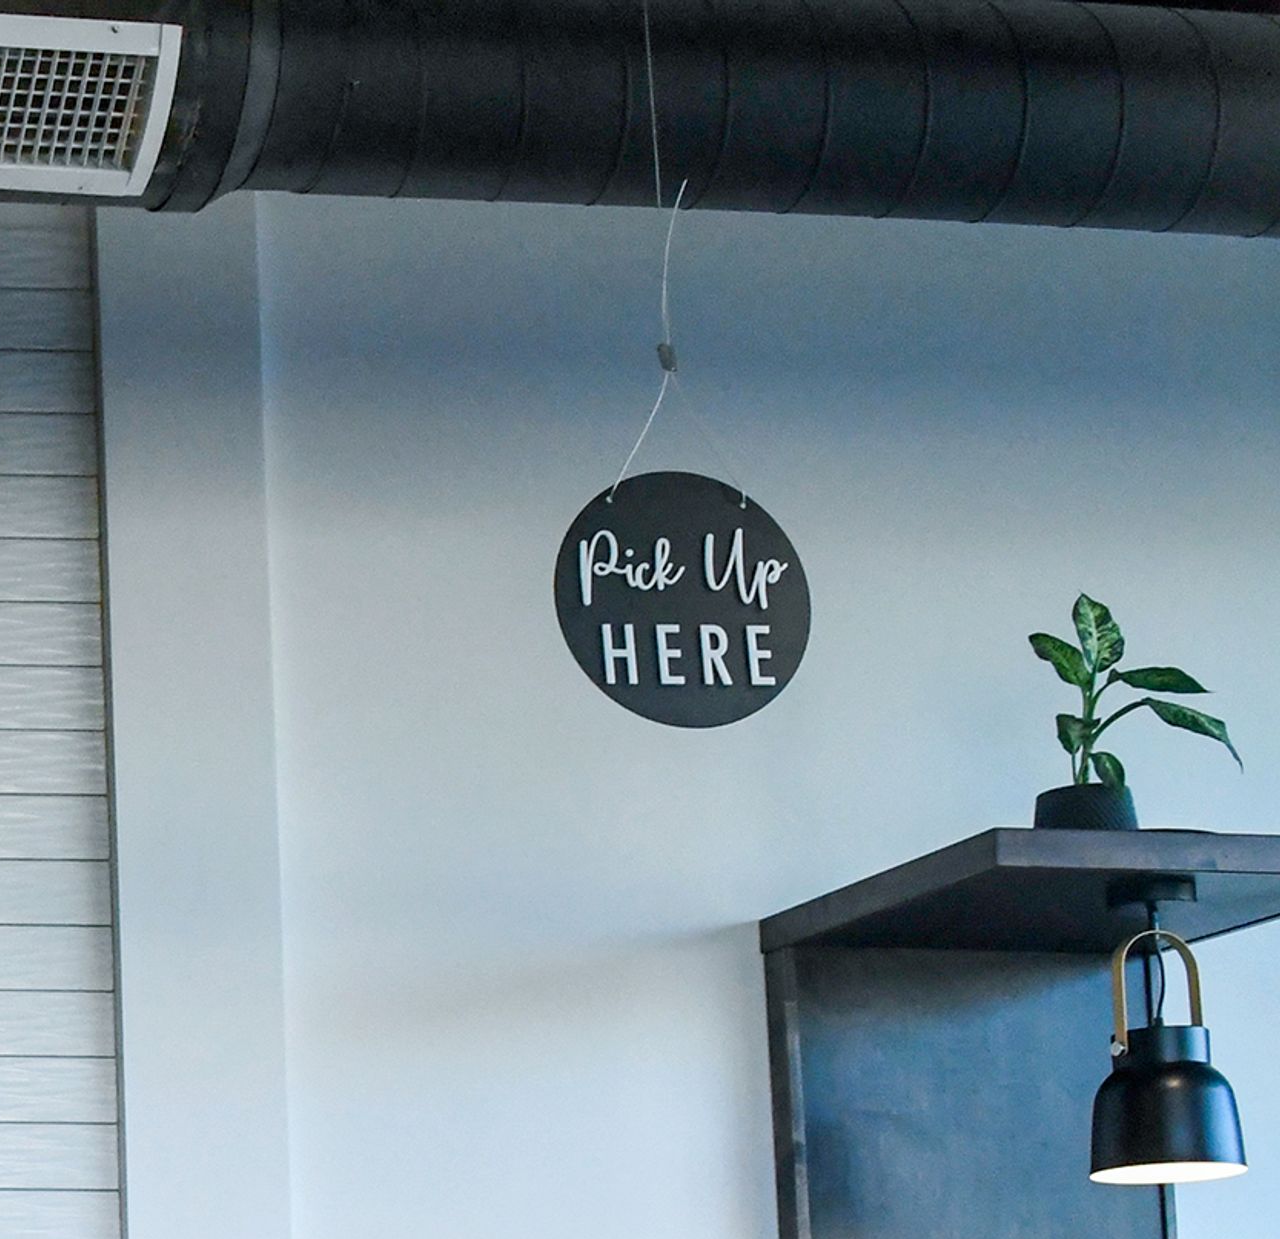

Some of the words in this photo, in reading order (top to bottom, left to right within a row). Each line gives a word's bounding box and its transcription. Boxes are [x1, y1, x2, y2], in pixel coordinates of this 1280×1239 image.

[579, 529, 686, 606] Pick
[704, 528, 788, 610] Up
[601, 623, 776, 686] HERE
